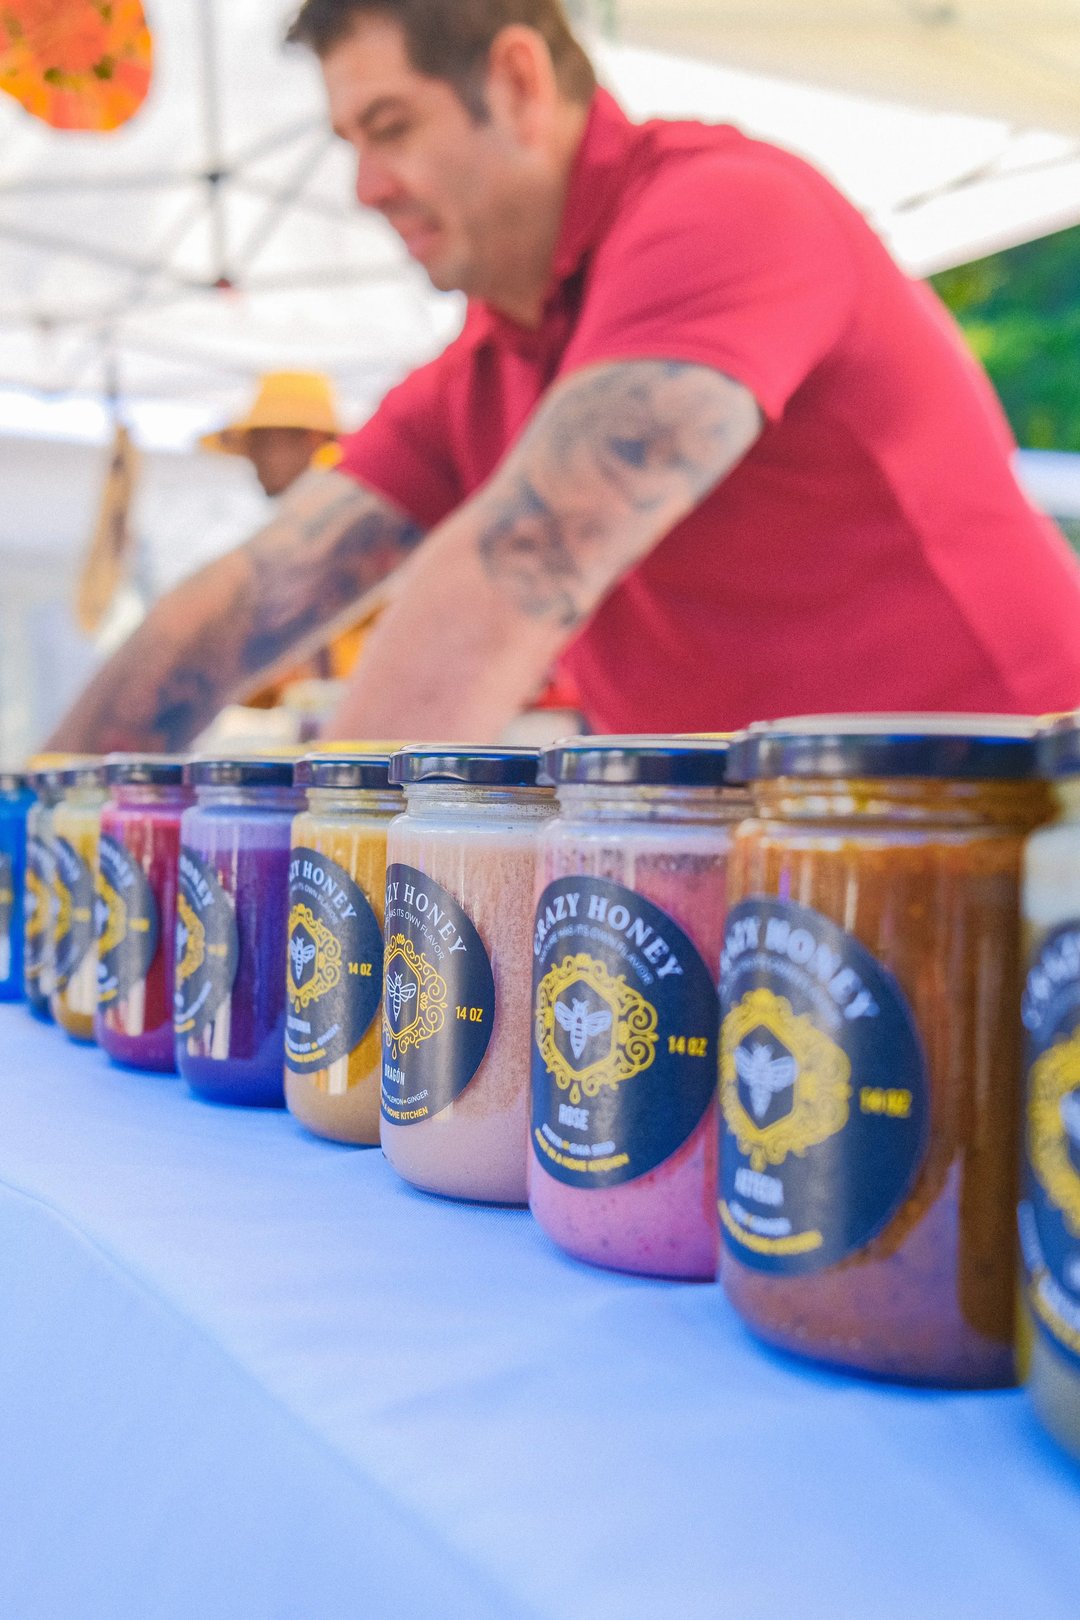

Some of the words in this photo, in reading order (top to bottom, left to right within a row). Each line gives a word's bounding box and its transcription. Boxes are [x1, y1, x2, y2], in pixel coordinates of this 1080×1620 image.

[302, 860, 357, 920] HONEY
[404, 883, 467, 955] HONEY
[405, 911, 421, 928] OWN
[420, 924, 445, 960] FLAVOR
[534, 892, 580, 956] CRAZY
[587, 894, 684, 979] HONEY
[348, 962, 359, 975] 14
[360, 963, 372, 976] OZ
[455, 1005, 467, 1020] 14
[469, 1007, 483, 1022] OZ
[668, 1035, 686, 1055] 14
[687, 1036, 708, 1057] OZ
[407, 1089, 428, 1104] GINGER
[401, 1106, 429, 1119] KITCHEN
